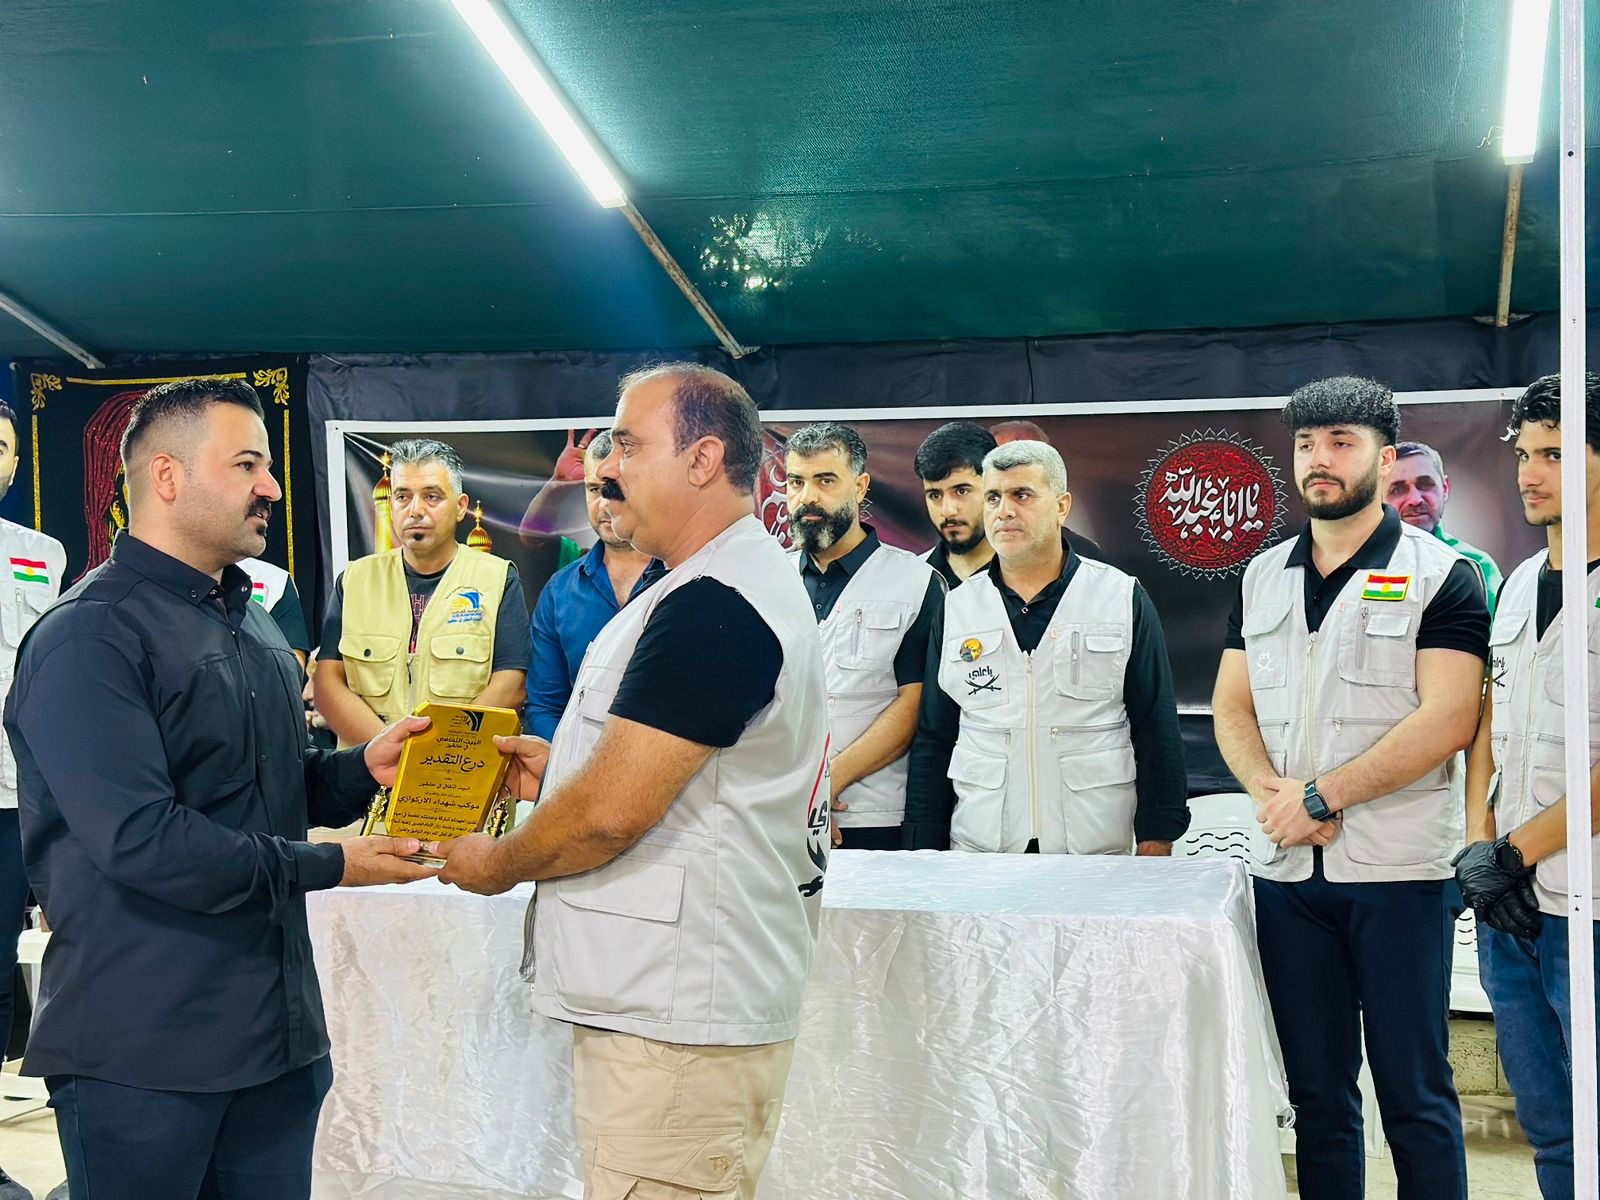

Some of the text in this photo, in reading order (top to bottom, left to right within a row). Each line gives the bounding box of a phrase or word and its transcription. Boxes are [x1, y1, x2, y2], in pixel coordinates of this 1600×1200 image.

[420, 752, 485, 773] درع التقدير
[433, 799, 457, 808] شهداء
[457, 802, 480, 810] موكب
